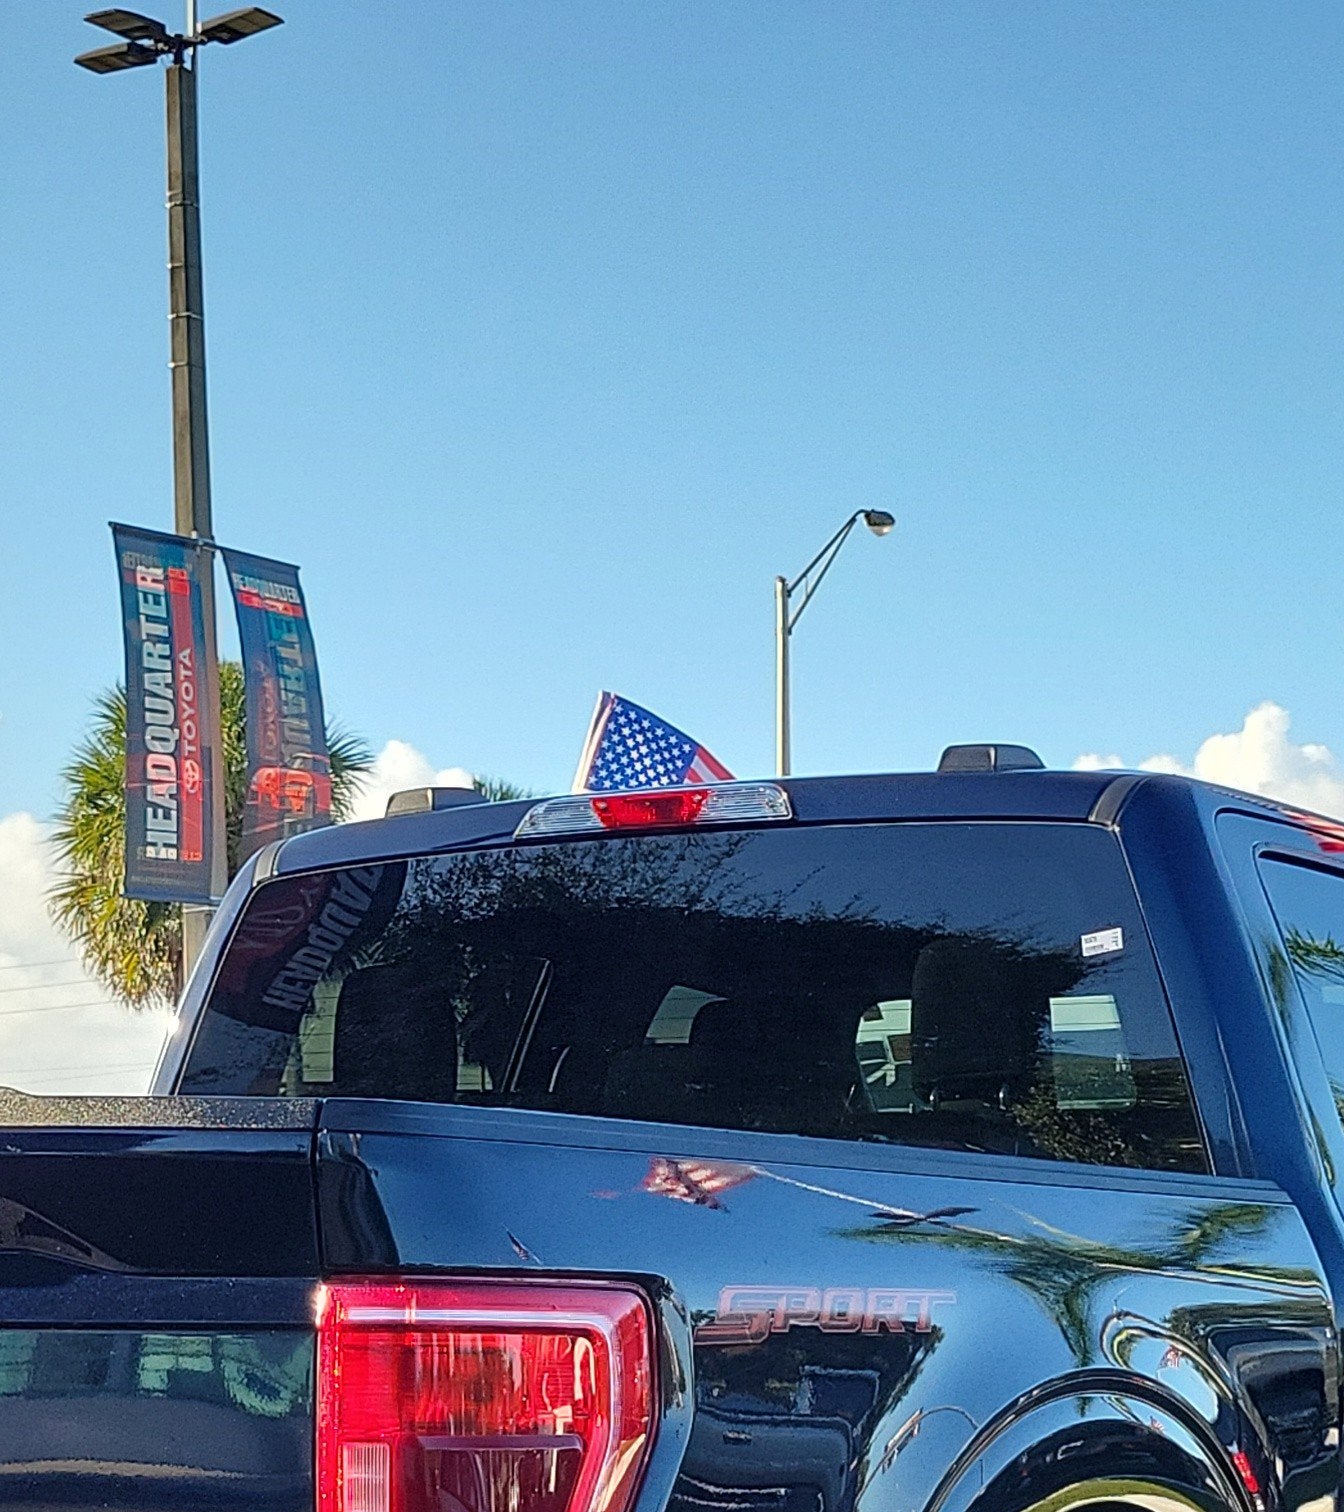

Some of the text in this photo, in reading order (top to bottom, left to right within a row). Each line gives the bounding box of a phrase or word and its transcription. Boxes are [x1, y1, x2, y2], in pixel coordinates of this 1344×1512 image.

[136, 565, 179, 860] HEADQUARTER
[178, 647, 199, 758] TOYOTA
[694, 1285, 957, 1346] SPORT
